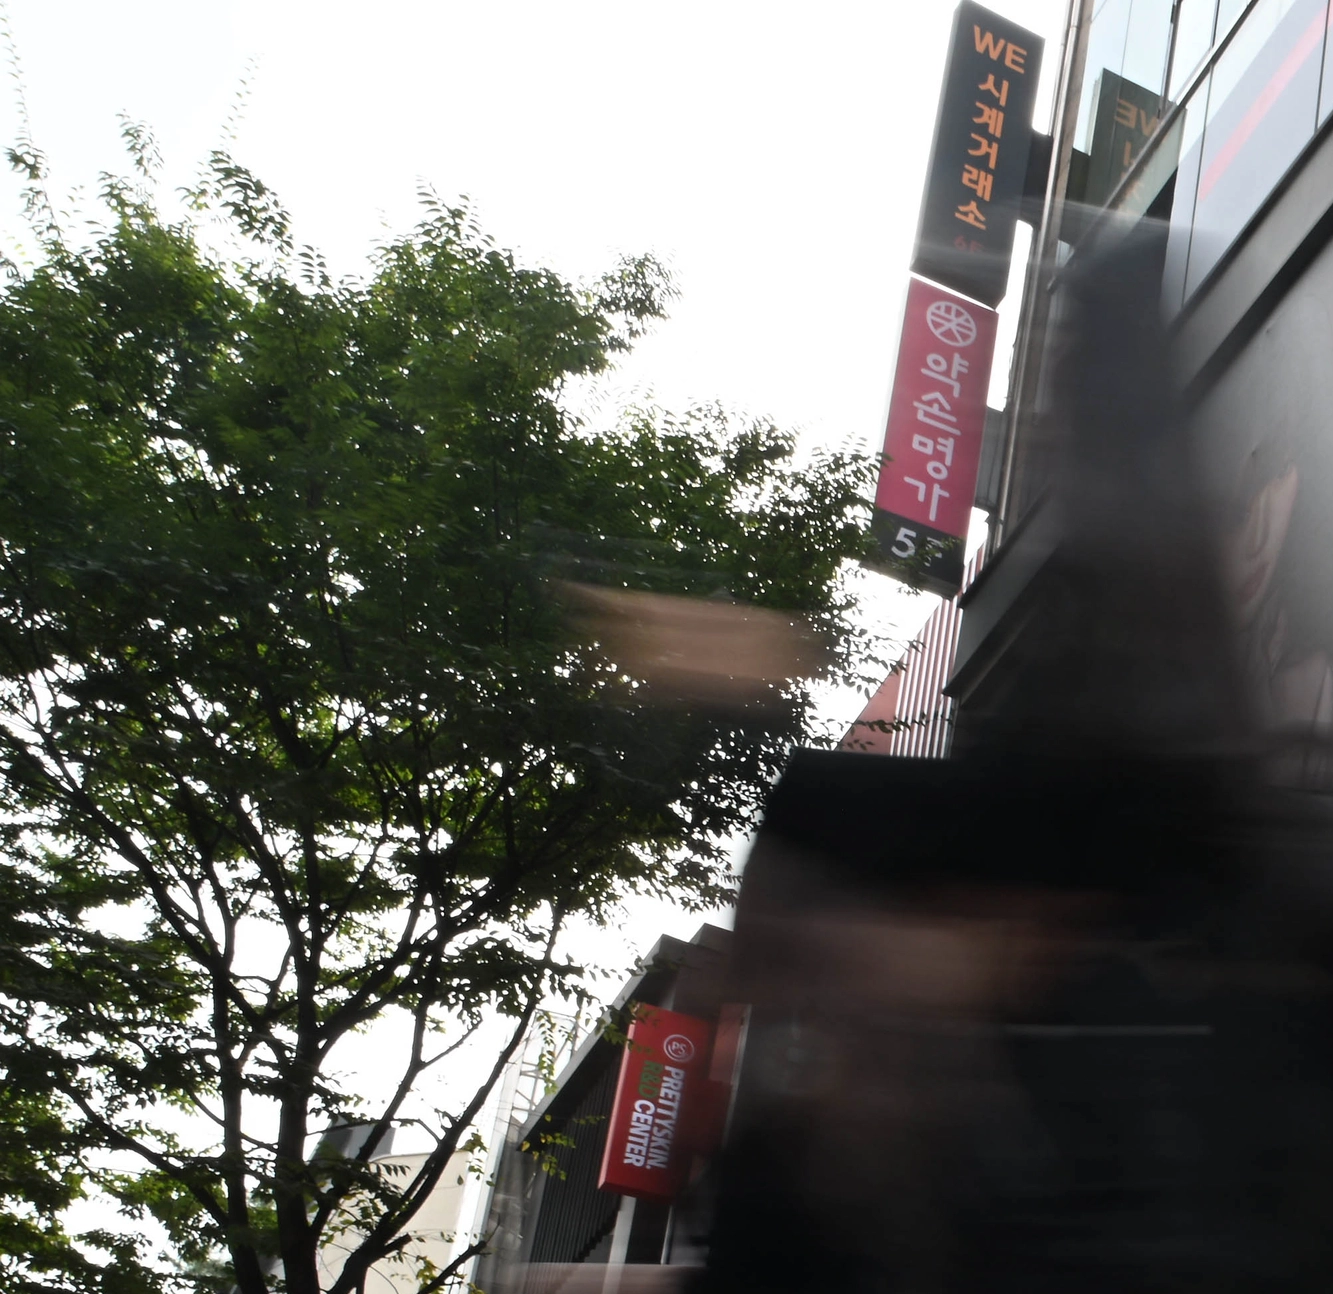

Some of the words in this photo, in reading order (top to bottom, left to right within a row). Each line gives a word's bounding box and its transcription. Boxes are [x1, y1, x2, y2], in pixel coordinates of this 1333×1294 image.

[973, 24, 1028, 74] WE
[955, 73, 1010, 231] 시계거래소
[903, 352, 970, 523] 약손명가
[637, 1060, 664, 1099] R&D
[623, 1099, 655, 1168] CENTER
